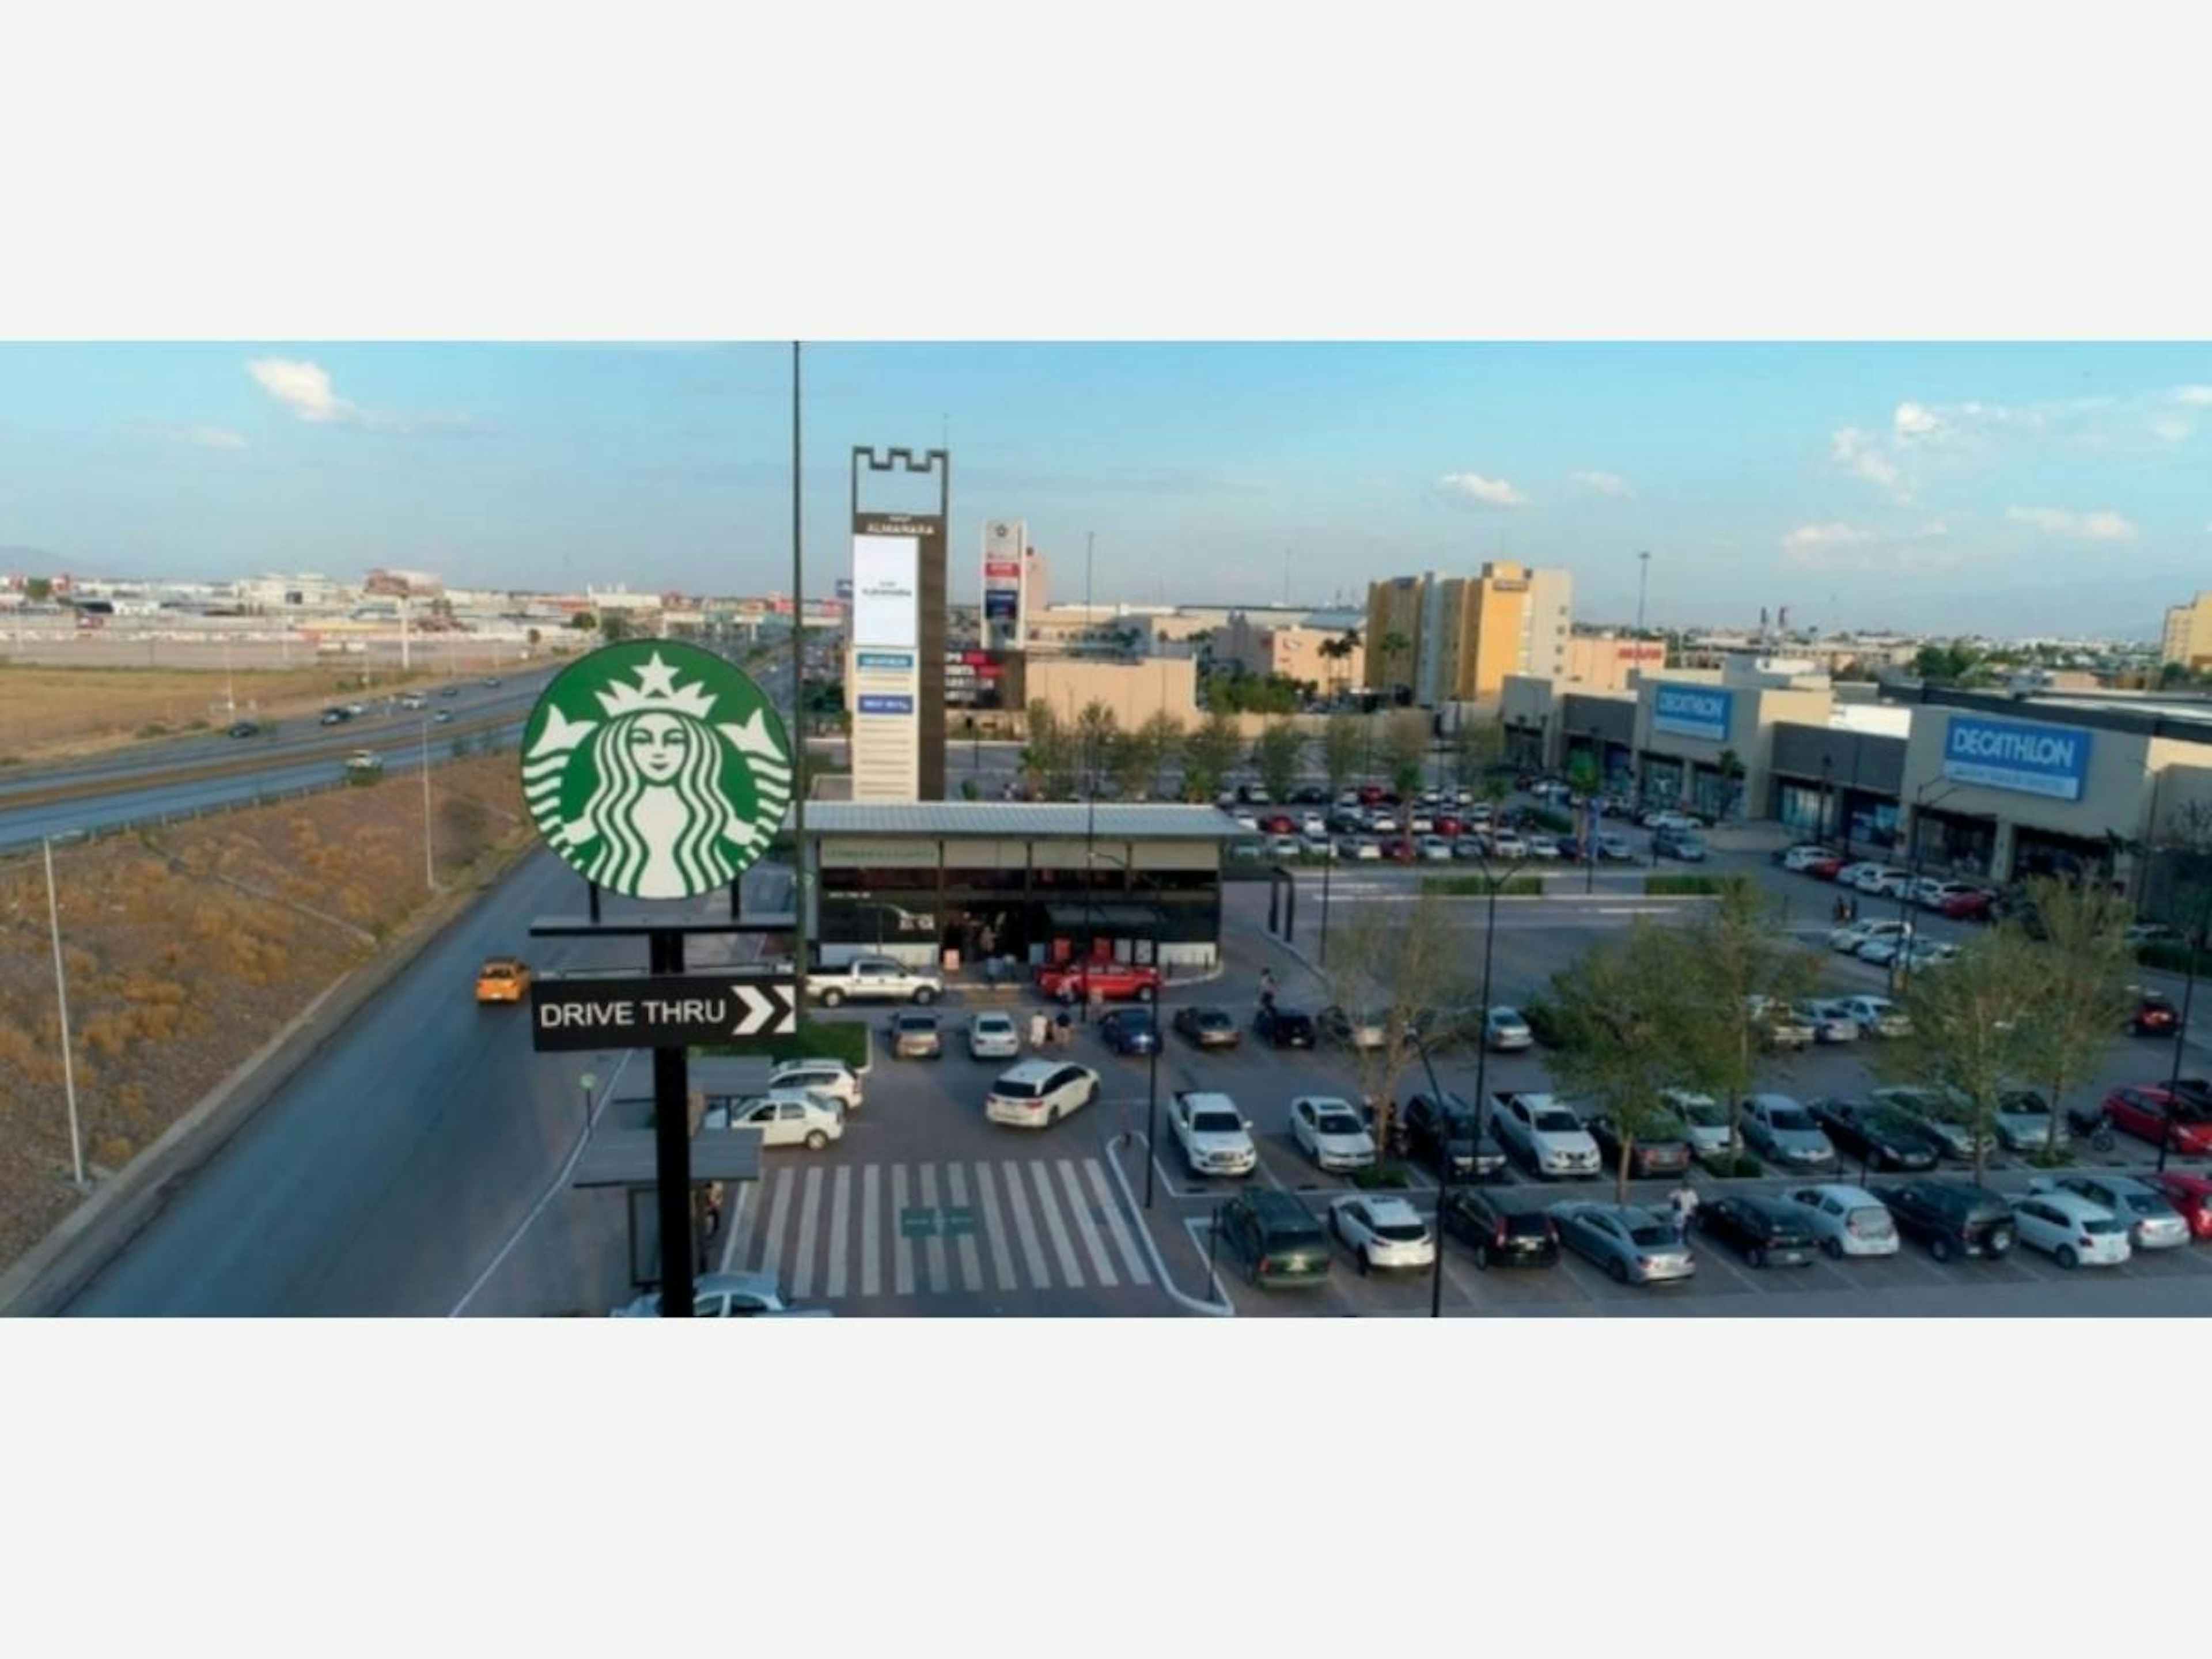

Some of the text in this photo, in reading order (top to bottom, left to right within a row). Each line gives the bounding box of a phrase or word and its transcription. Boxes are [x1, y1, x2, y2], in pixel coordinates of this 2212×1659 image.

[1953, 728, 2074, 767] DECATHLON
[539, 998, 726, 1028] DRIVE THRU
